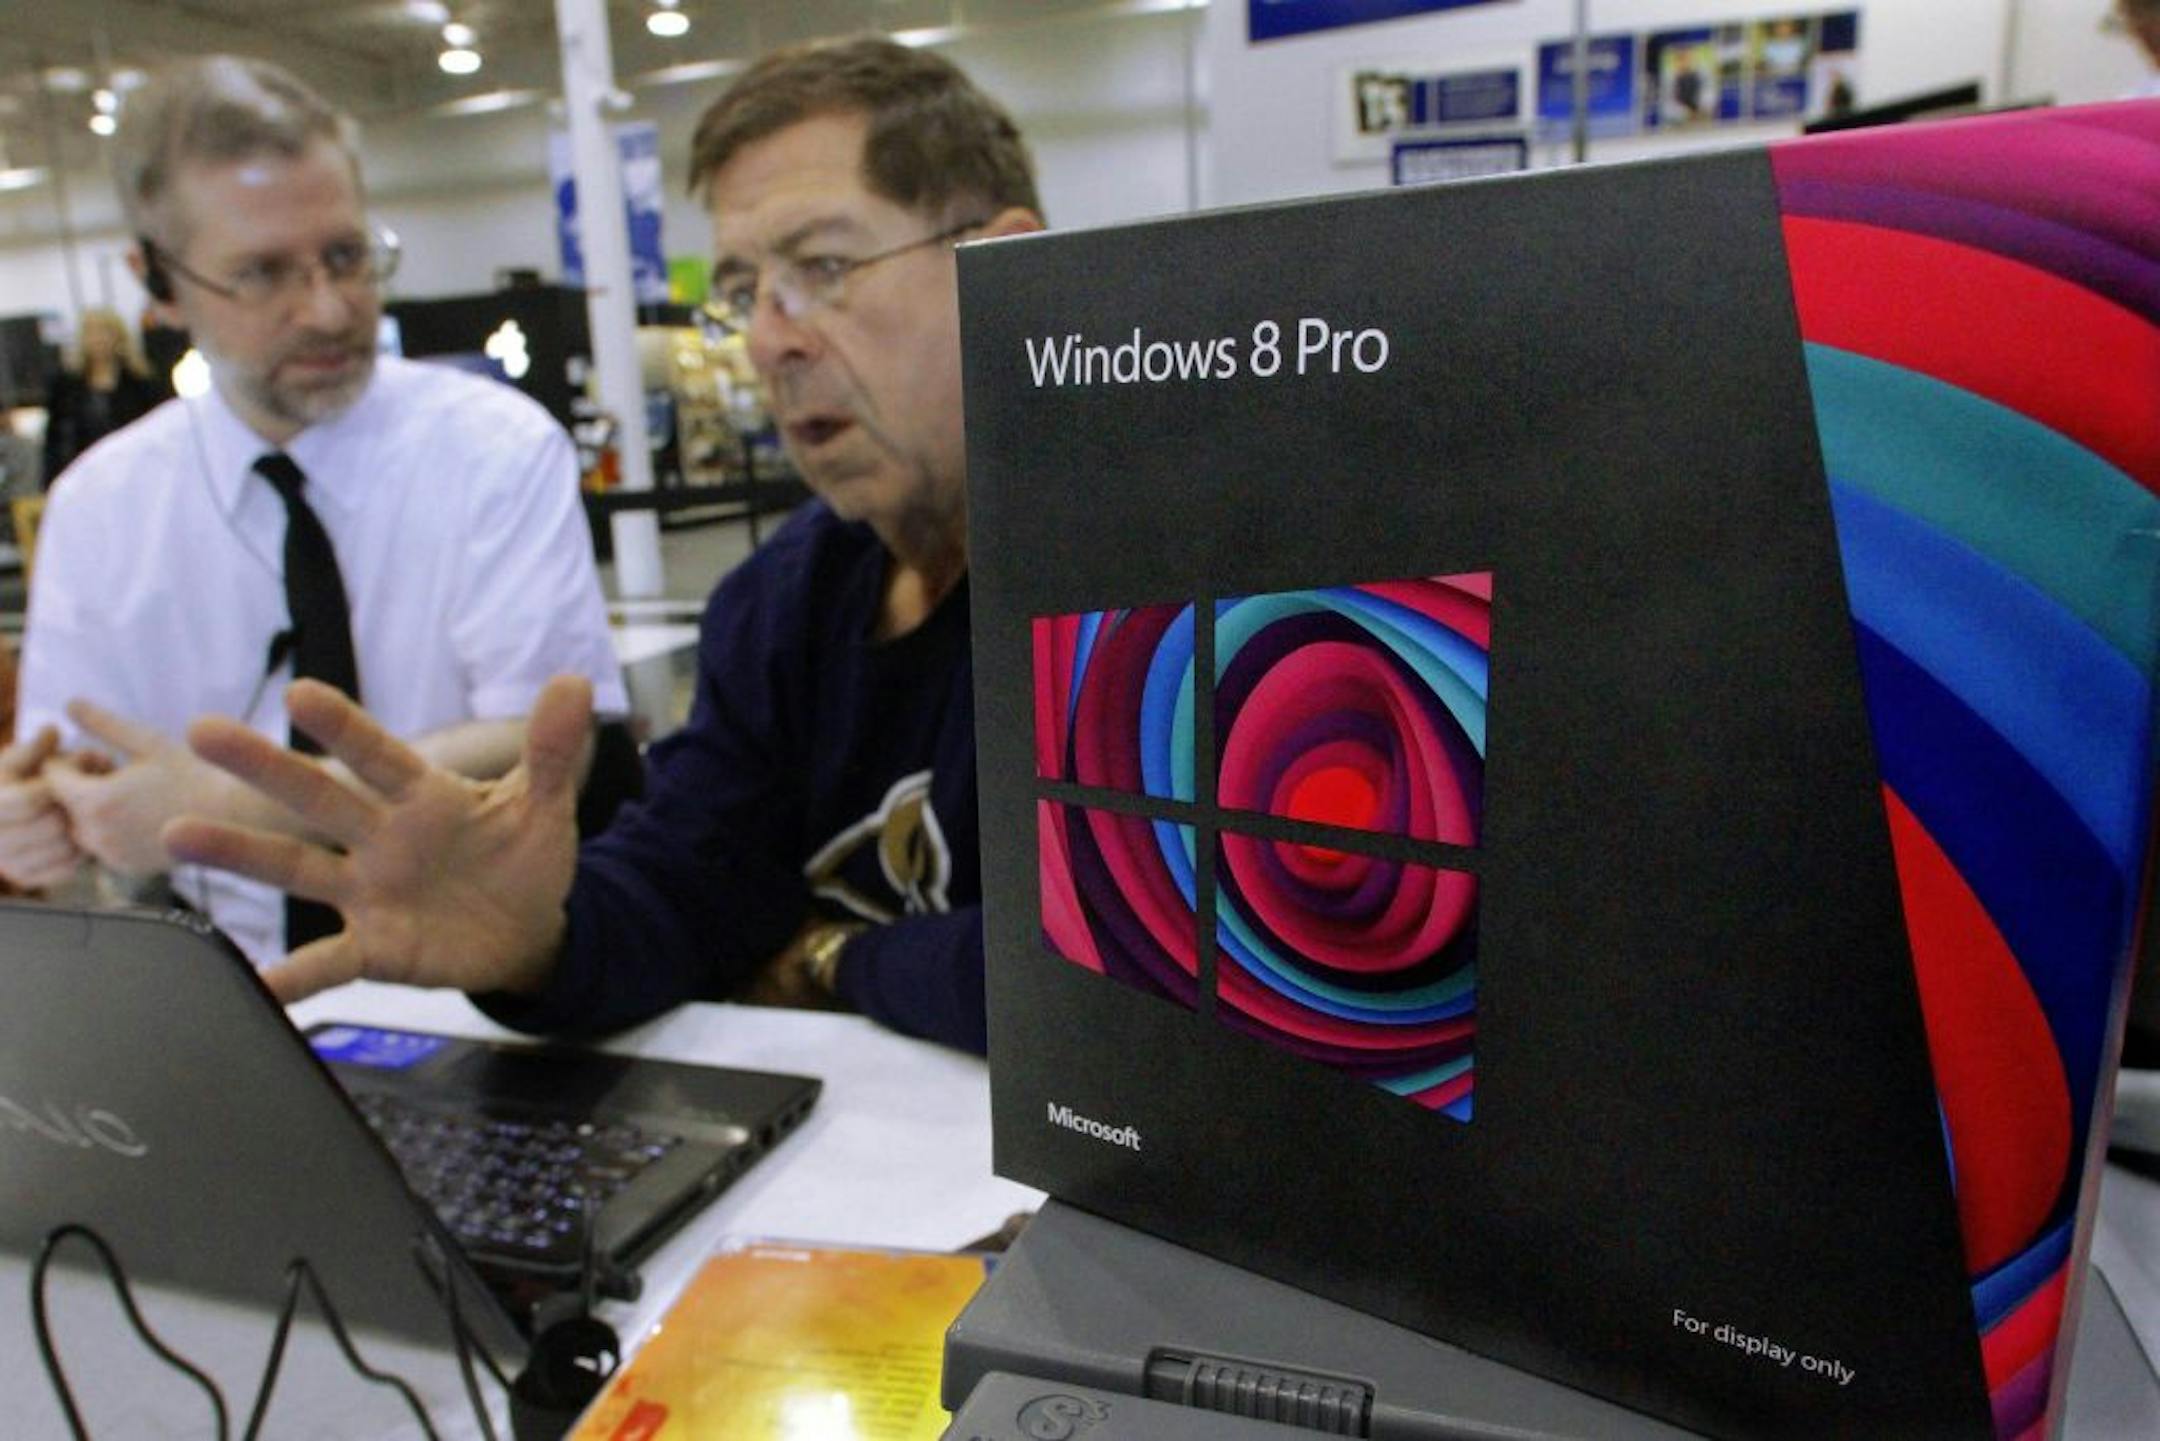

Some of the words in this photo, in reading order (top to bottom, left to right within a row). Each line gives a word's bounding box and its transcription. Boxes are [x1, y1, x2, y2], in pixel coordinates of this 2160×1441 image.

[1025, 328, 1237, 388] Windows
[1250, 319, 1282, 377] 8
[1298, 317, 1390, 375] Pro
[1047, 1101, 1141, 1151] Microsoft
[1672, 1308, 1709, 1335] For
[1713, 1324, 1796, 1367] display
[1801, 1354, 1855, 1386] only
